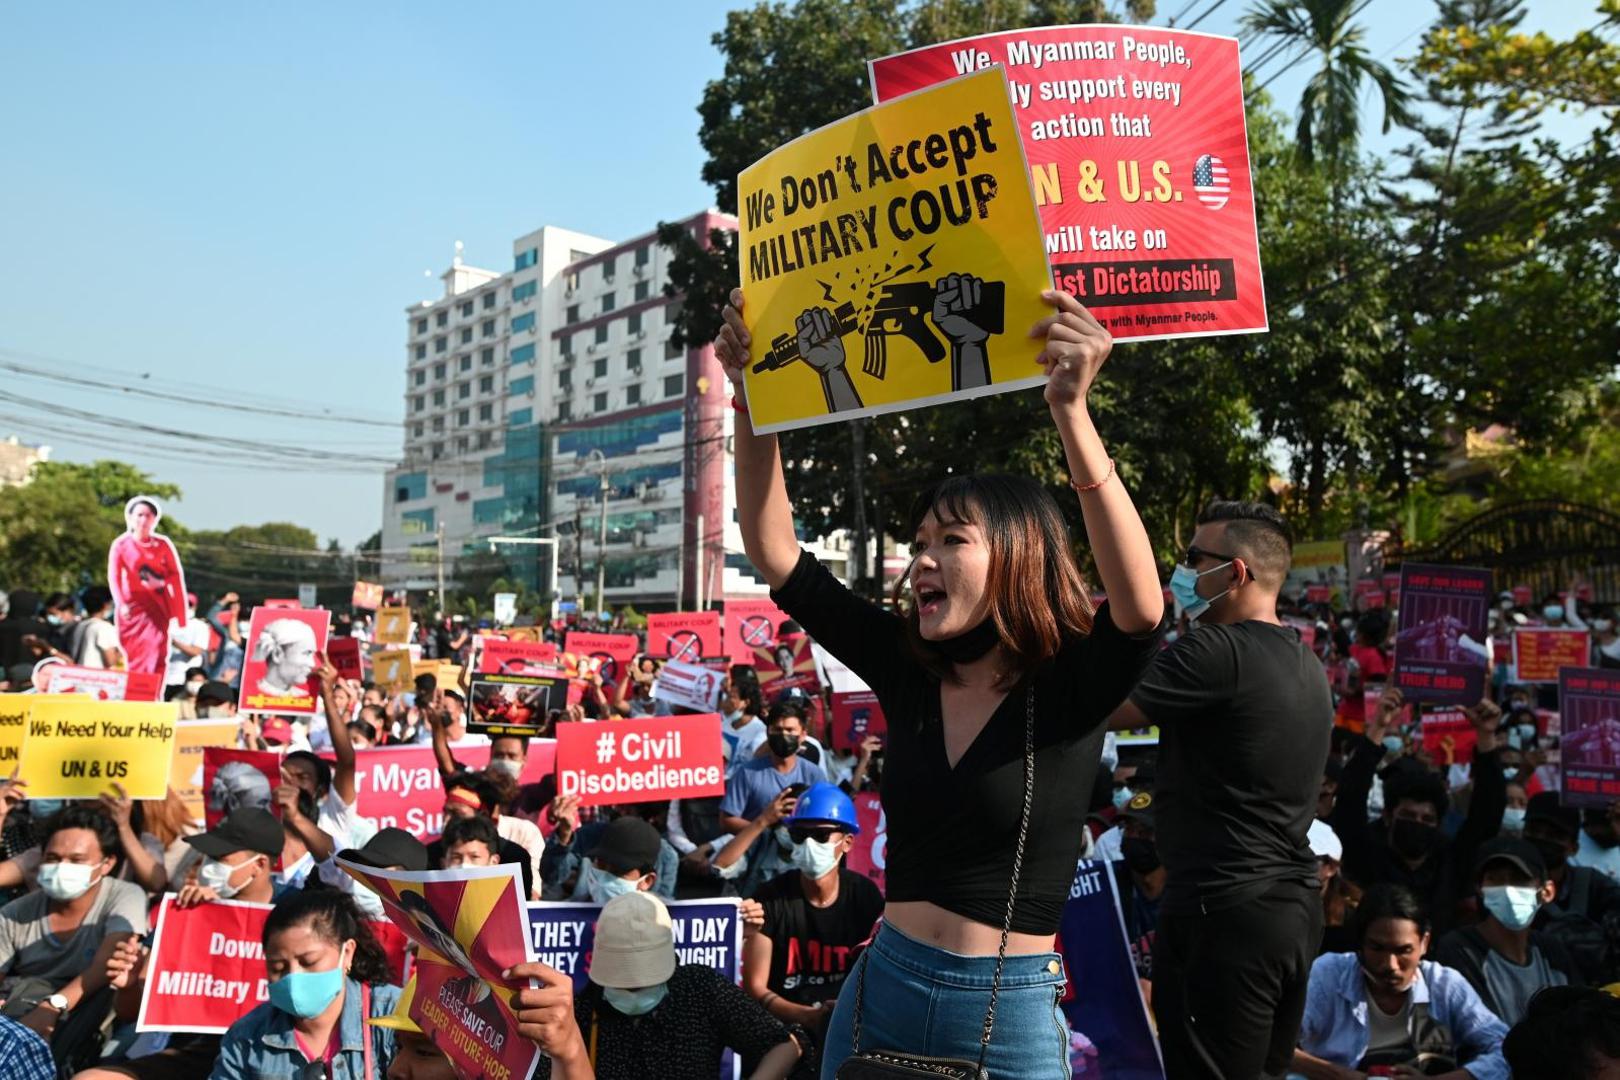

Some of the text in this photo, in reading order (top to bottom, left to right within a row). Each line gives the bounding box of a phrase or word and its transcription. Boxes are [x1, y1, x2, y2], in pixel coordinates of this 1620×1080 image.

[1006, 40, 1116, 69] Myanmar
[1122, 36, 1192, 69] People,
[1039, 75, 1126, 104] support
[1132, 79, 1181, 107] every
[1031, 112, 1152, 141] action that
[746, 112, 998, 232] We Don't Accept
[1078, 159, 1106, 203] &
[1117, 159, 1183, 203] U.S.
[749, 174, 998, 283] MILITARY COUP
[1046, 225, 1167, 254] will take on
[1093, 263, 1221, 298] Dictatorship
[1110, 313, 1133, 327] with
[1135, 312, 1183, 328] Myanmar
[1184, 310, 1219, 323] People.
[653, 618, 713, 629] MILITARY COUP
[489, 645, 550, 658] MILITARY COUP
[572, 640, 631, 651] MILITARY COUP
[30, 721, 173, 743] We Need Your Help
[596, 731, 682, 764] # Civil
[61, 761, 128, 778] UN & US
[561, 764, 720, 796] Disobedience
[532, 921, 586, 948] THEY
[691, 917, 729, 943] DAY
[157, 970, 251, 1005] Military
[420, 996, 449, 1033] LEADER
[450, 1024, 483, 1063] FUTURE
[438, 985, 505, 1053] PLEASE SAVE OUR
